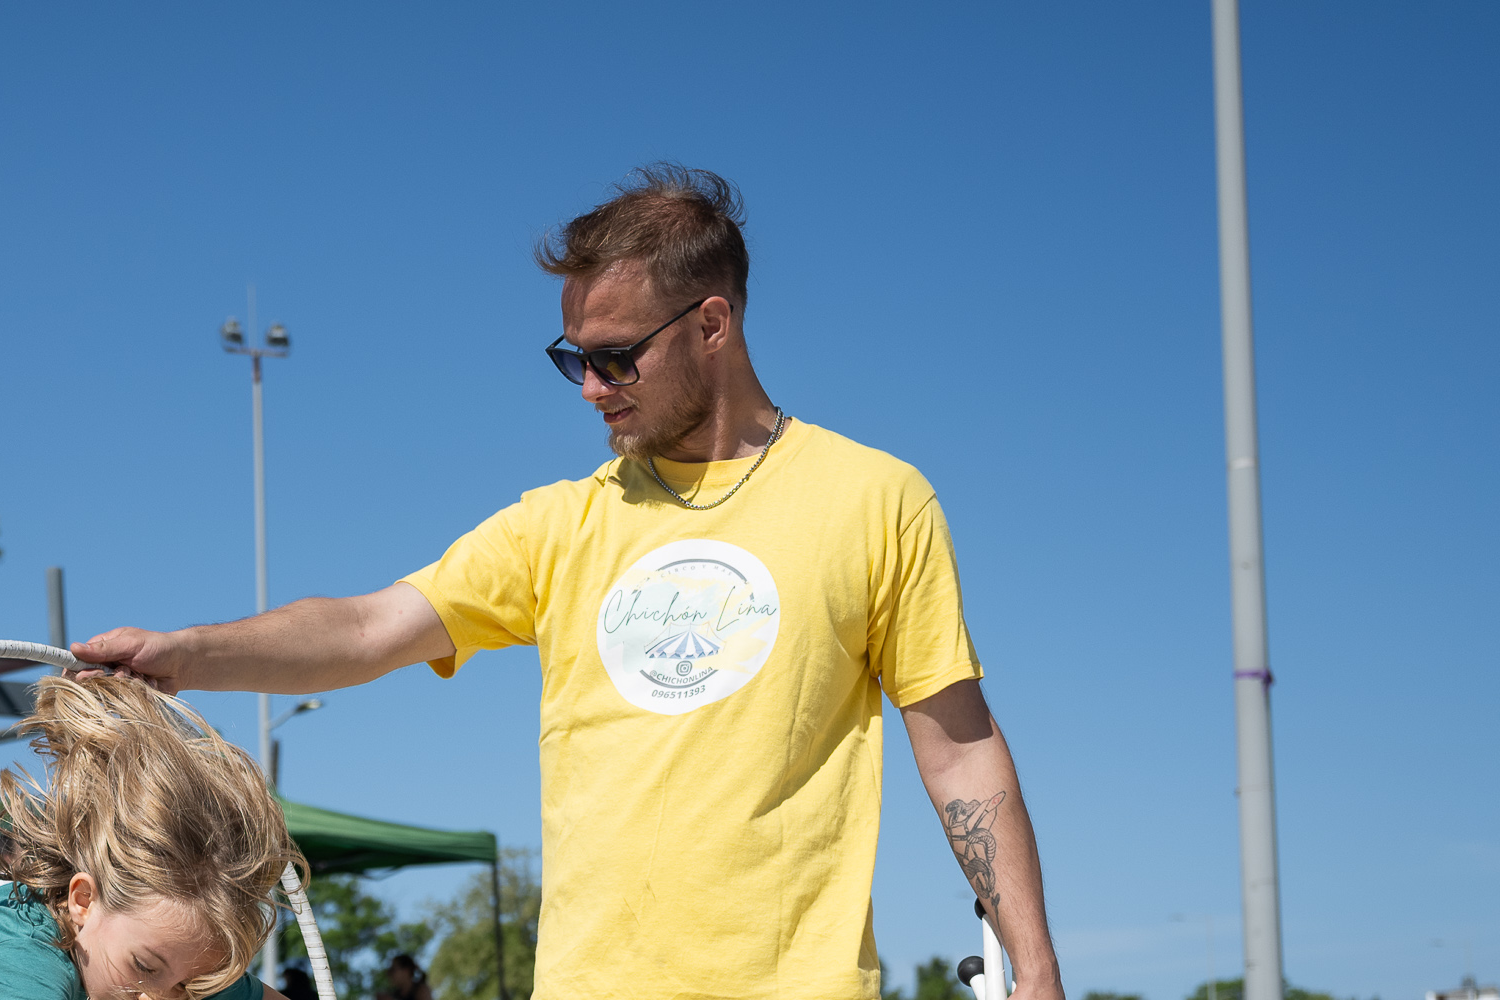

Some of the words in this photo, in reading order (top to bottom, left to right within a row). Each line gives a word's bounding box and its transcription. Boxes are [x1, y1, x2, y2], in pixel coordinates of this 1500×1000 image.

[715, 585, 778, 632] Lina
[649, 665, 713, 684] @CHICHONLINA
[651, 684, 706, 699] 096511393
